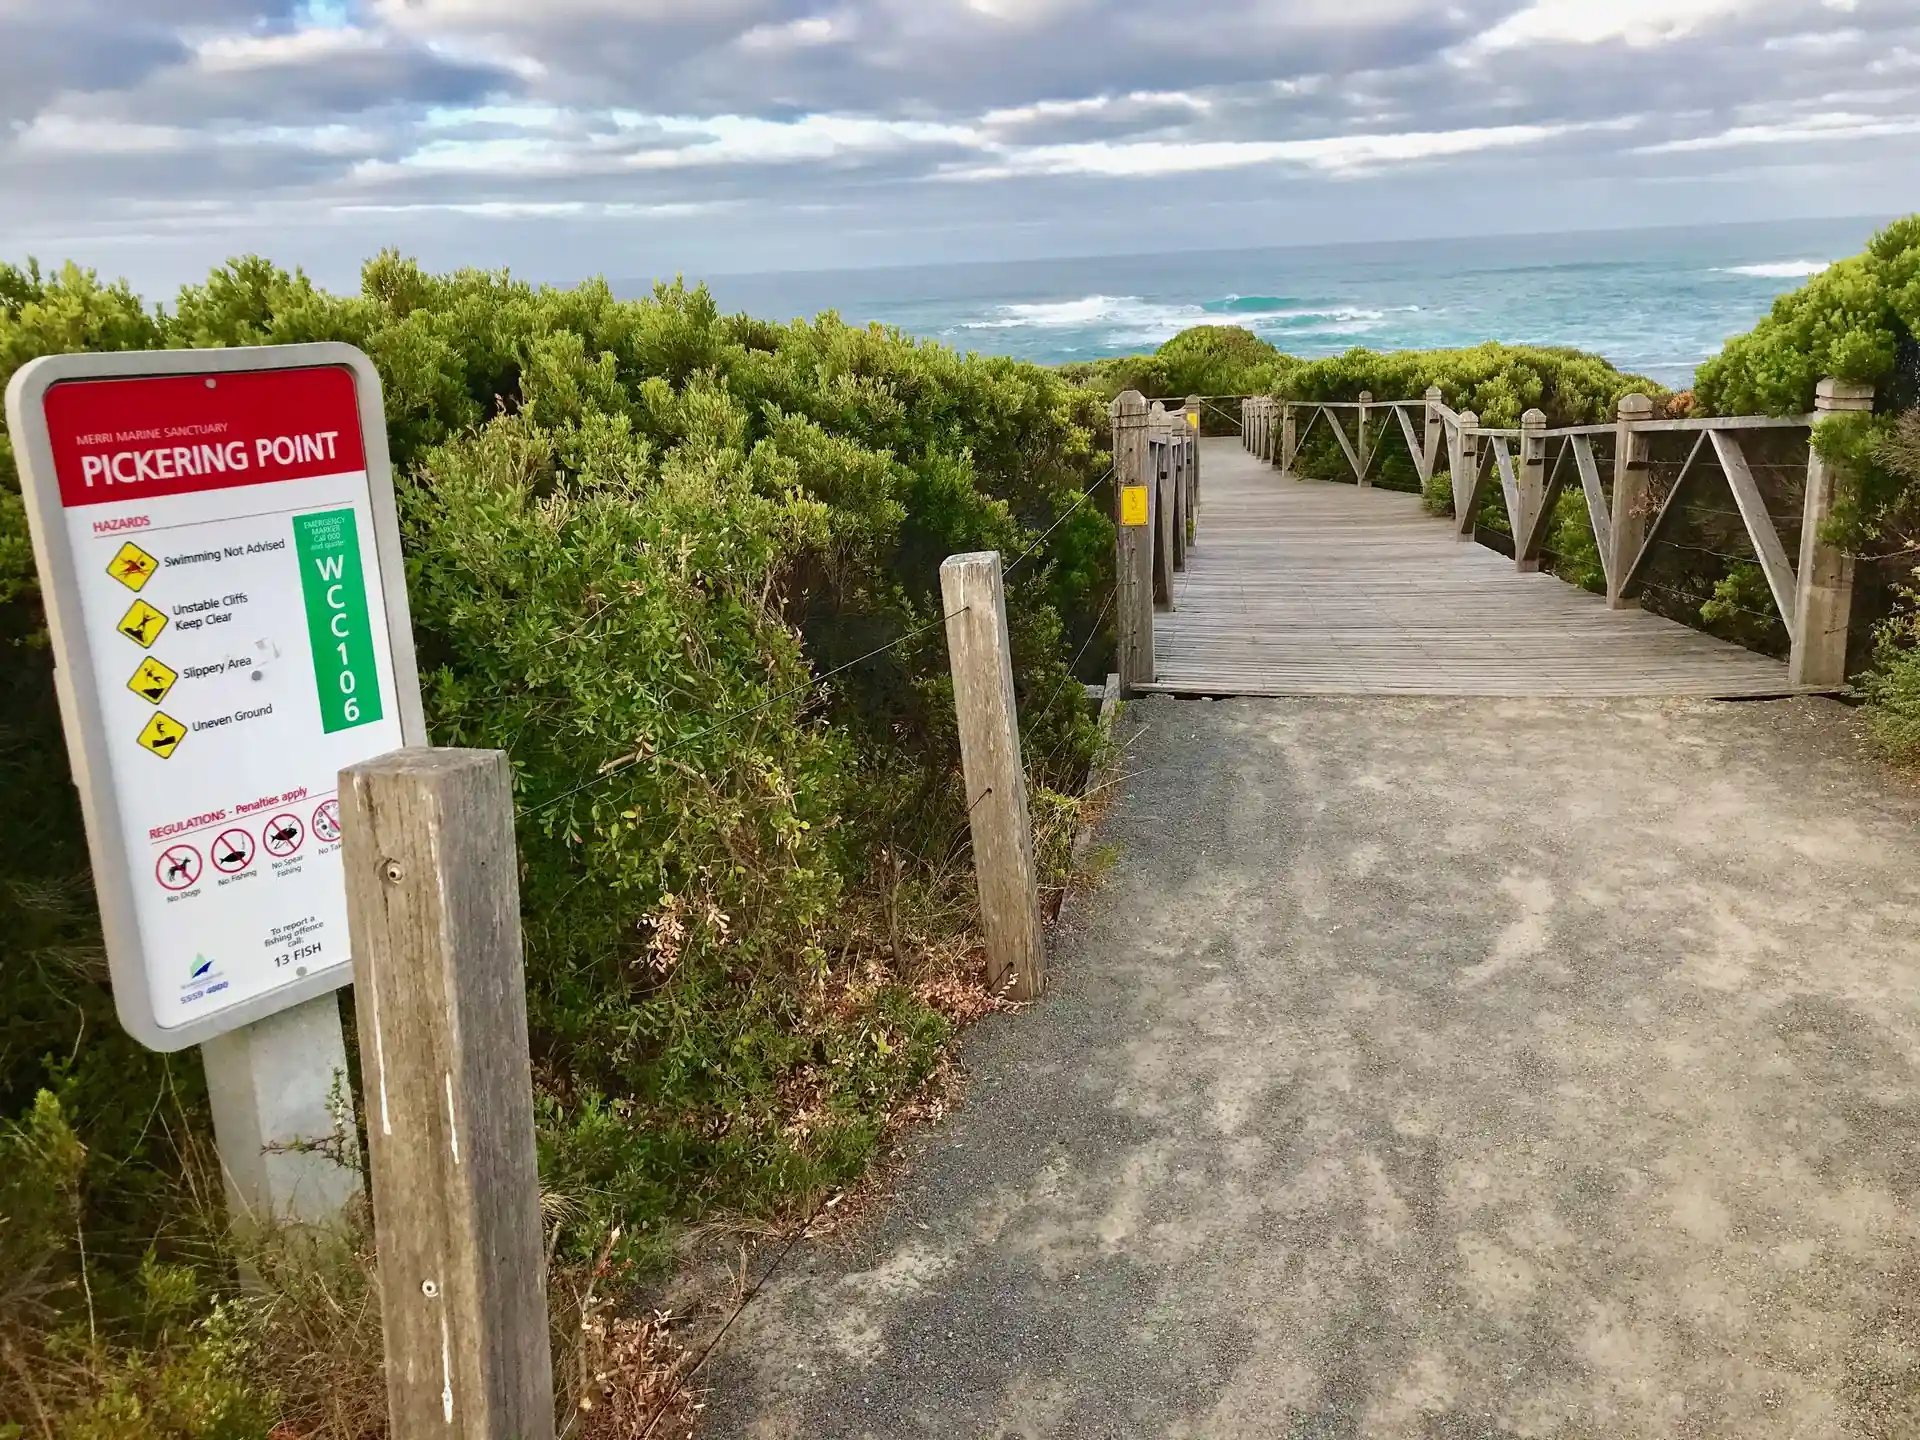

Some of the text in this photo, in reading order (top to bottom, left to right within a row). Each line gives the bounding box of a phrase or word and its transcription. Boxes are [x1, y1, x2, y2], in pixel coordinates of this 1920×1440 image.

[76, 422, 229, 446] MERRI MARINE SANCTUARY
[81, 431, 339, 488] PICKERING POINT
[93, 515, 151, 533] HAZARDS
[303, 516, 346, 529] EMERGENCY
[164, 538, 286, 568] Swimming Not Advised
[172, 592, 249, 616] Unstable Cliffs
[175, 611, 233, 632] Keep Clear
[183, 656, 252, 680] Slippery Area
[192, 703, 274, 732] Uneven Ground
[149, 808, 227, 840] REGULATIONS
[235, 794, 280, 815] Penalties
[281, 785, 308, 804] apply
[271, 854, 304, 870] No Spear
[318, 846, 331, 856] No
[217, 868, 258, 888] No Fishing
[276, 865, 303, 879] Fishing
[166, 888, 202, 904] No Dogs
[263, 921, 325, 948] fishing offence
[270, 927, 282, 936] To
[282, 917, 309, 932] report
[274, 941, 322, 968] 13 FISH
